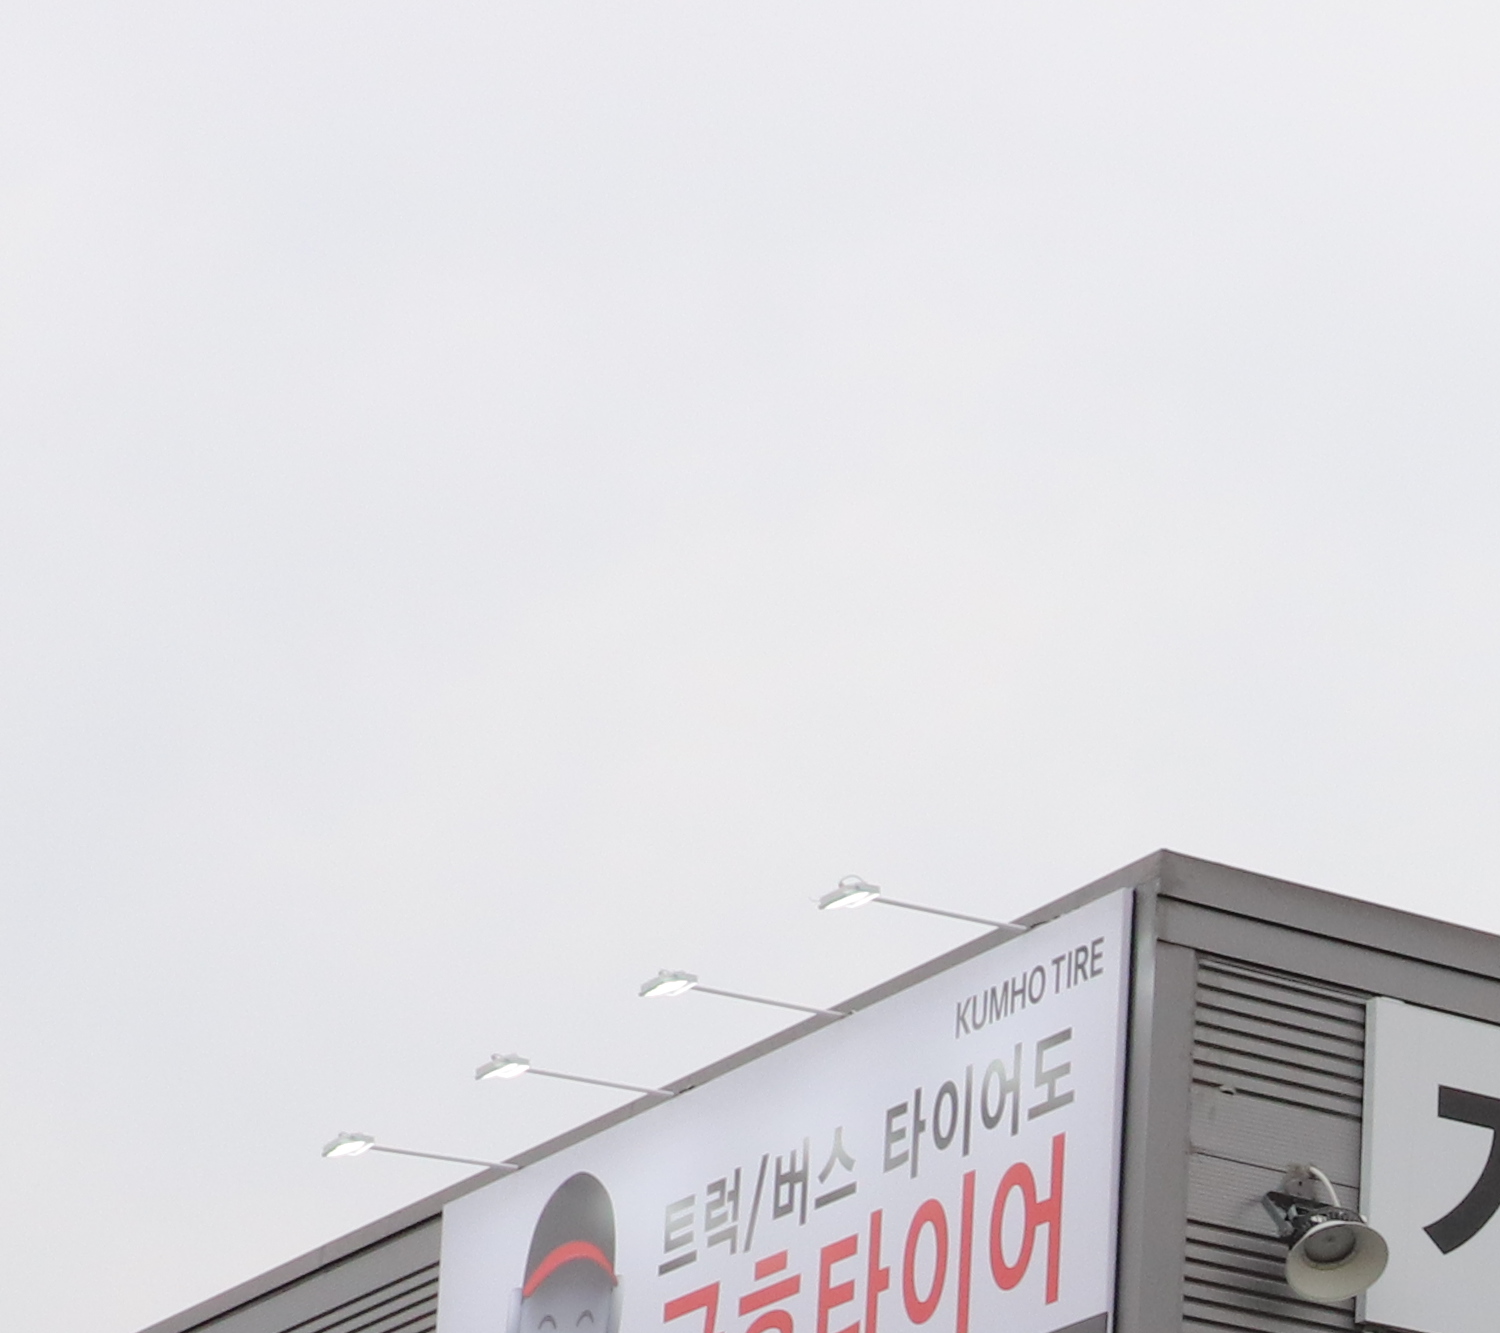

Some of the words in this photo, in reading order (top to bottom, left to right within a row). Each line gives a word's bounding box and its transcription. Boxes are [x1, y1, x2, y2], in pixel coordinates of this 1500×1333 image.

[955, 966, 1046, 1040] KUMHO
[1051, 936, 1106, 996] TIRE
[658, 1126, 857, 1277] 트럭/버스
[883, 1027, 1076, 1178] 타이어도
